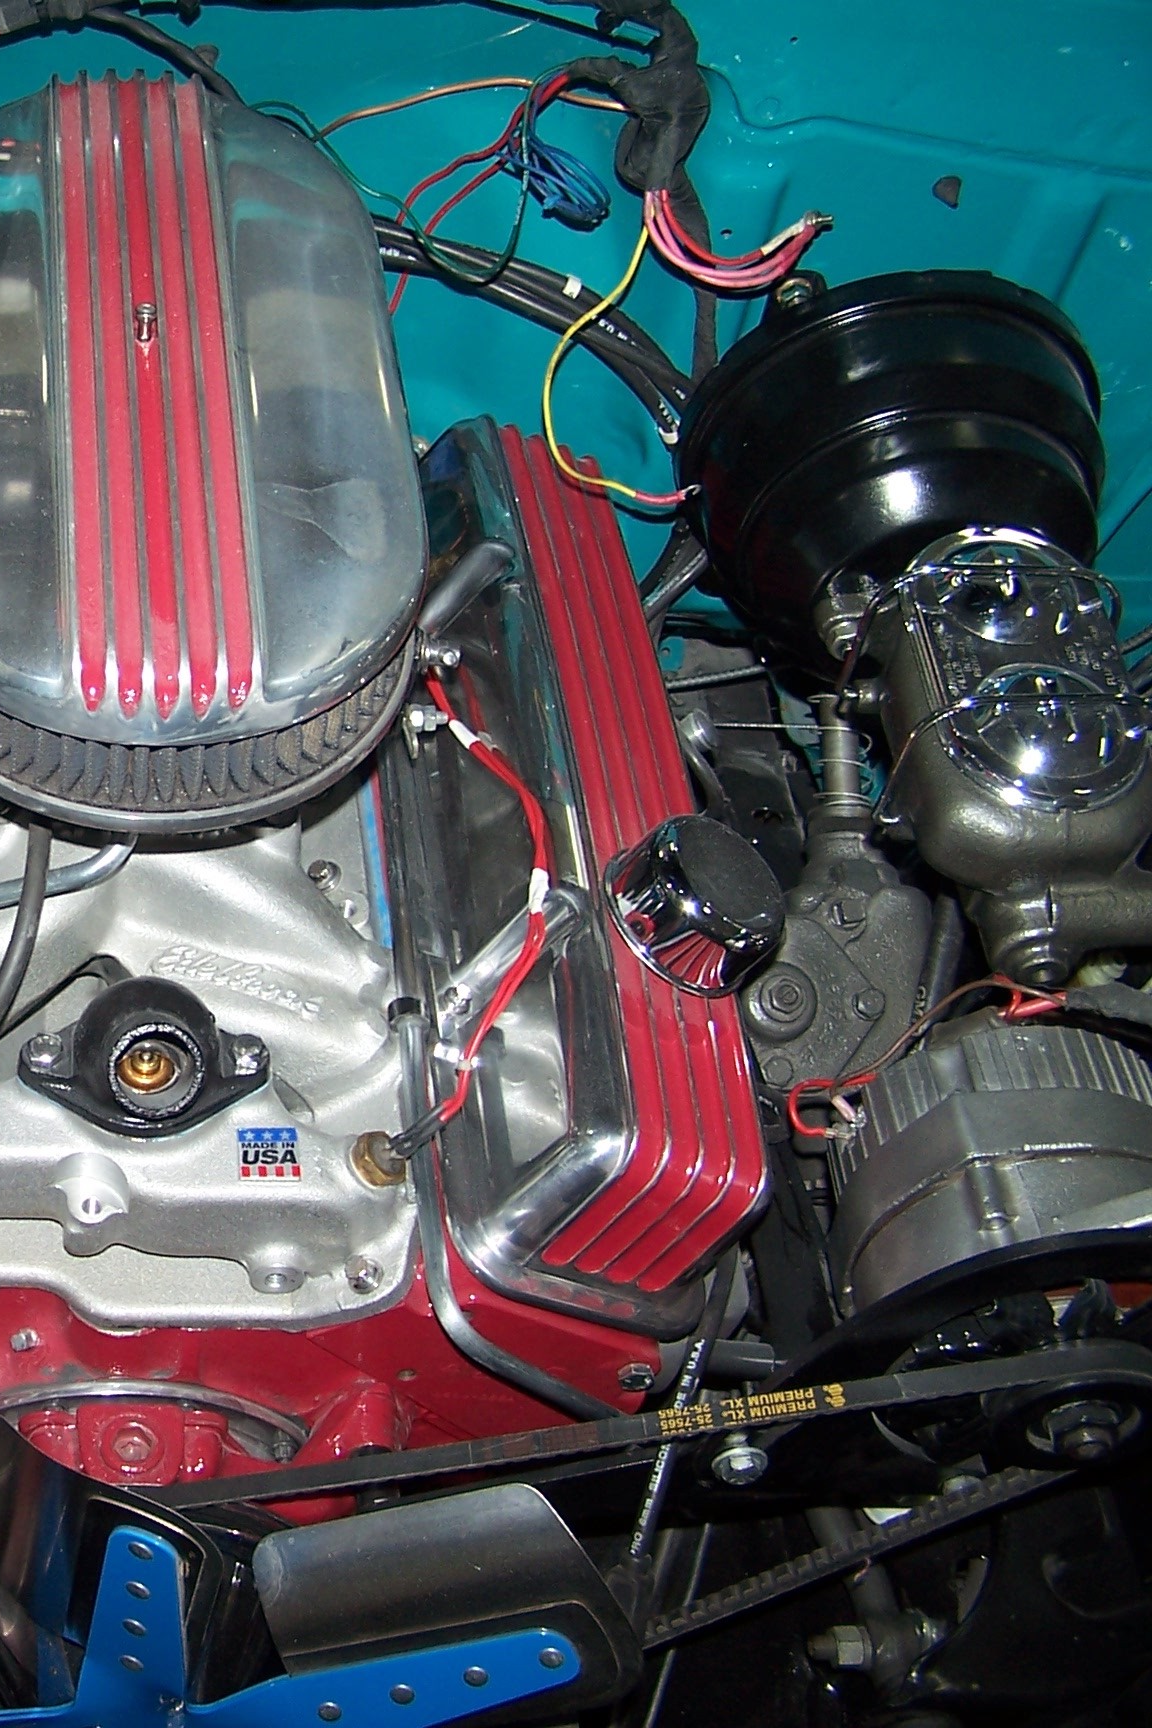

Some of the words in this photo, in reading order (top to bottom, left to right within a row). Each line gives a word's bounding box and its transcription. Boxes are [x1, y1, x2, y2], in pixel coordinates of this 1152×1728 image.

[242, 1150, 297, 1165] USA
[681, 1374, 694, 1387] IN
[748, 1387, 814, 1404] PREMIUM
[657, 1402, 712, 1418] 25-7565
[750, 1399, 817, 1417] PREMIUM
[660, 1413, 714, 1430] 25-7565
